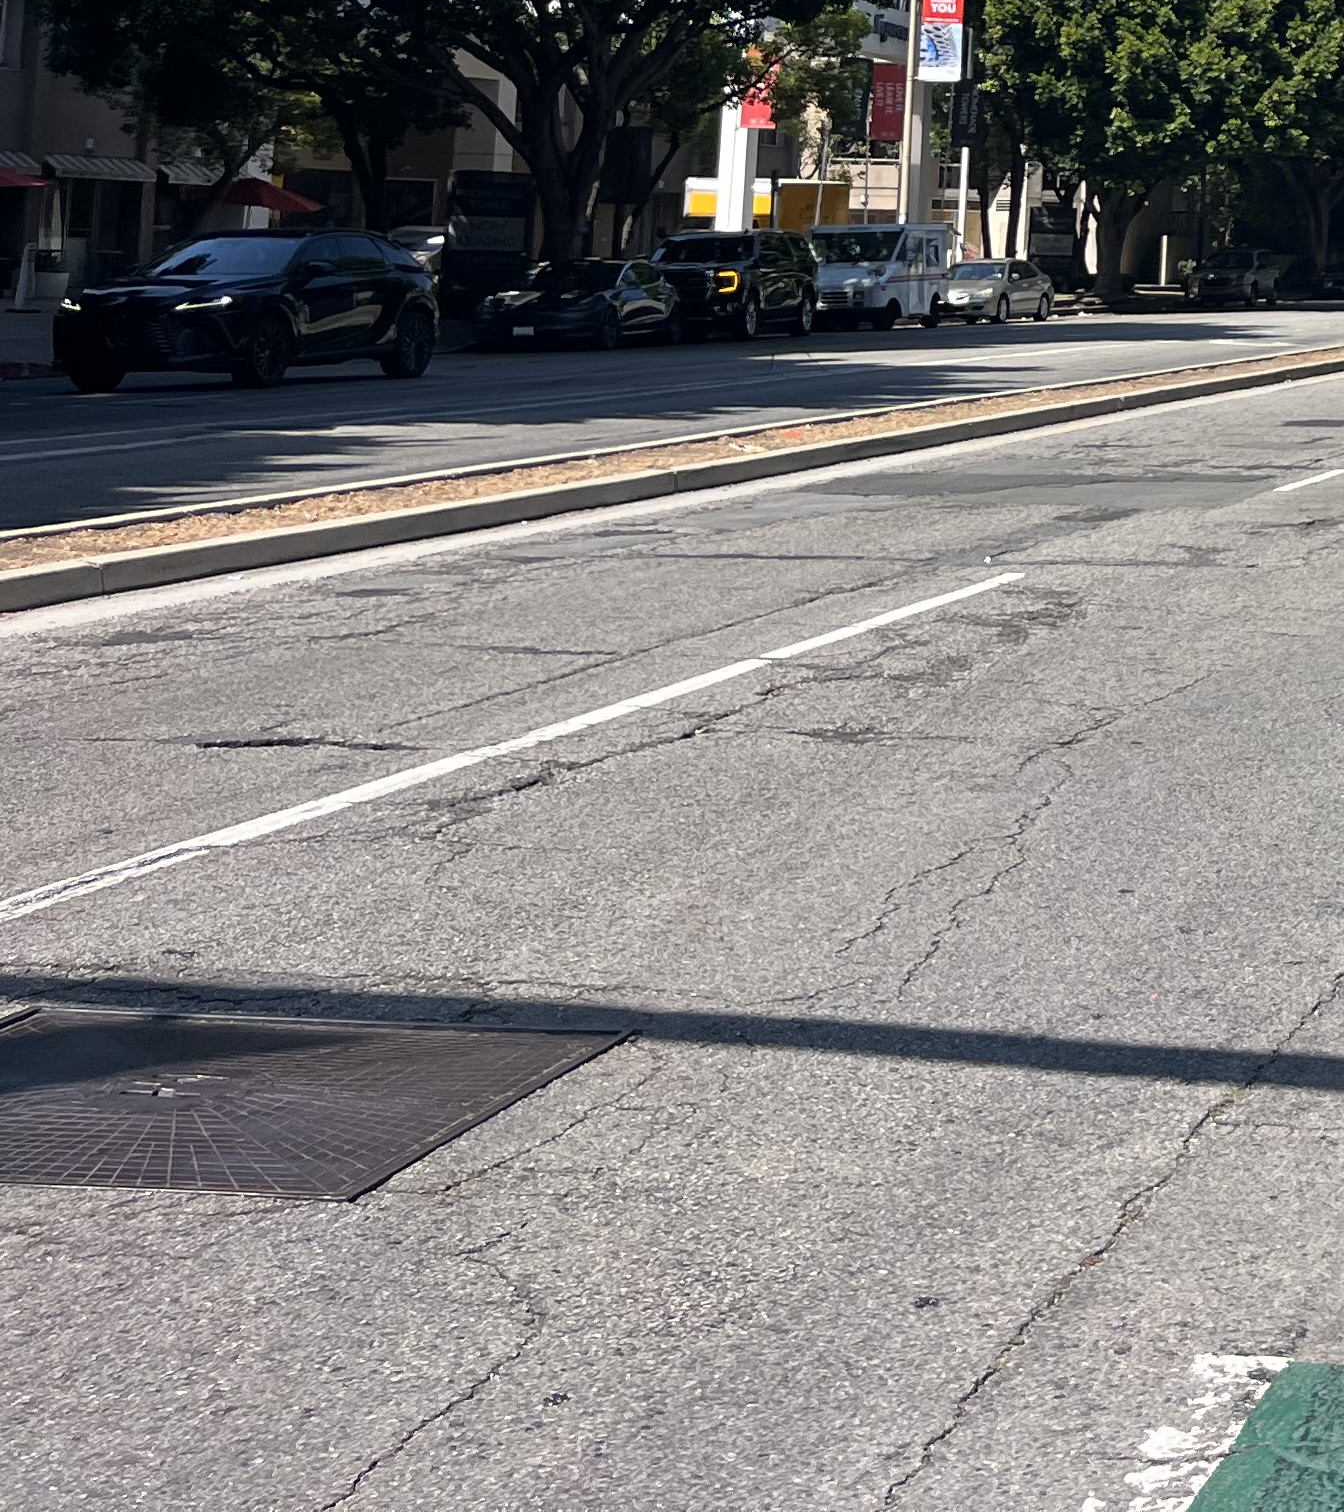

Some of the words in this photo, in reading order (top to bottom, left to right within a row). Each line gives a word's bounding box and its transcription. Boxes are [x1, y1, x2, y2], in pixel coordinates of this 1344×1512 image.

[931, 3, 957, 14] YOU
[875, 81, 885, 99] LIVE
[885, 82, 894, 105] LEASE
[895, 82, 904, 103] LOVE
